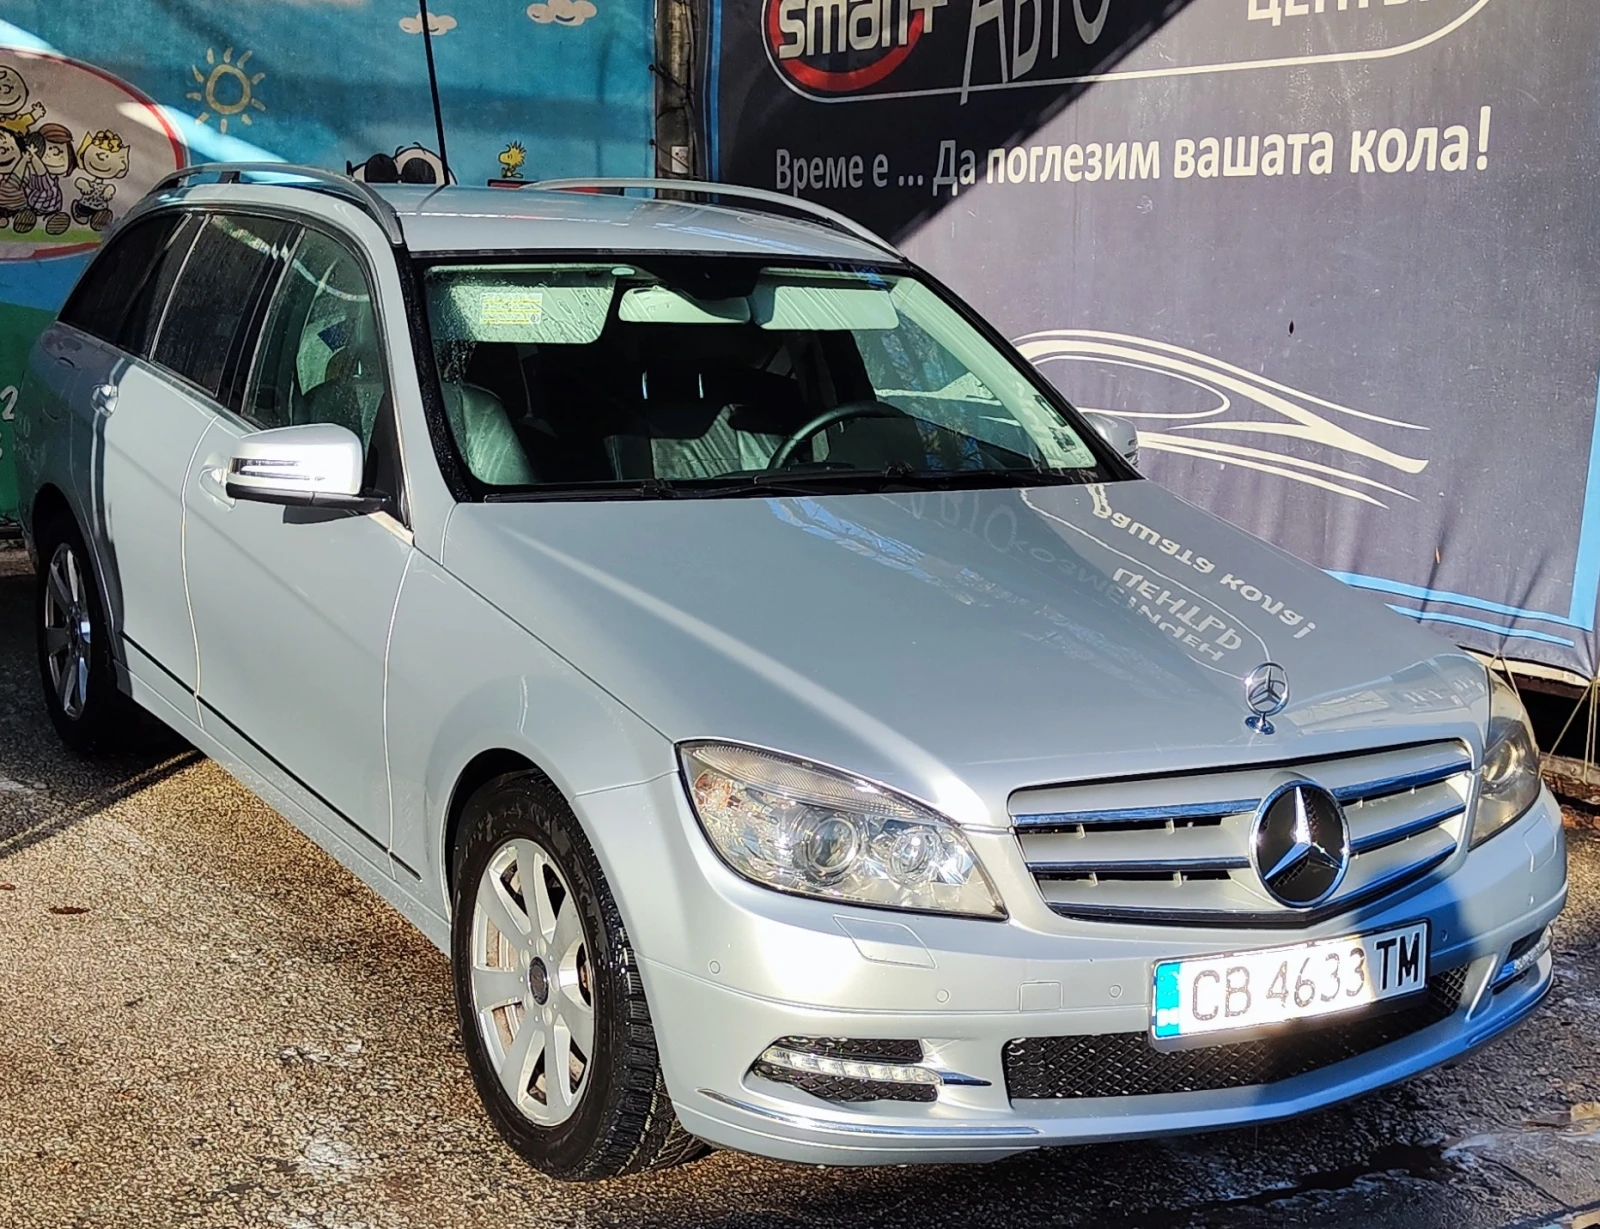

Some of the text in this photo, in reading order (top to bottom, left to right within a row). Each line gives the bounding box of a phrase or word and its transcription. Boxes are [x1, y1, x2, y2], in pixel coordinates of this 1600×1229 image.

[776, 148, 864, 196] Време
[872, 153, 889, 187] е
[932, 139, 976, 197] Да
[986, 140, 1160, 186] поглезим
[1173, 131, 1335, 179] вашата
[1350, 105, 1492, 174] кола!
[1192, 931, 1421, 1021] CB 4633 TM
